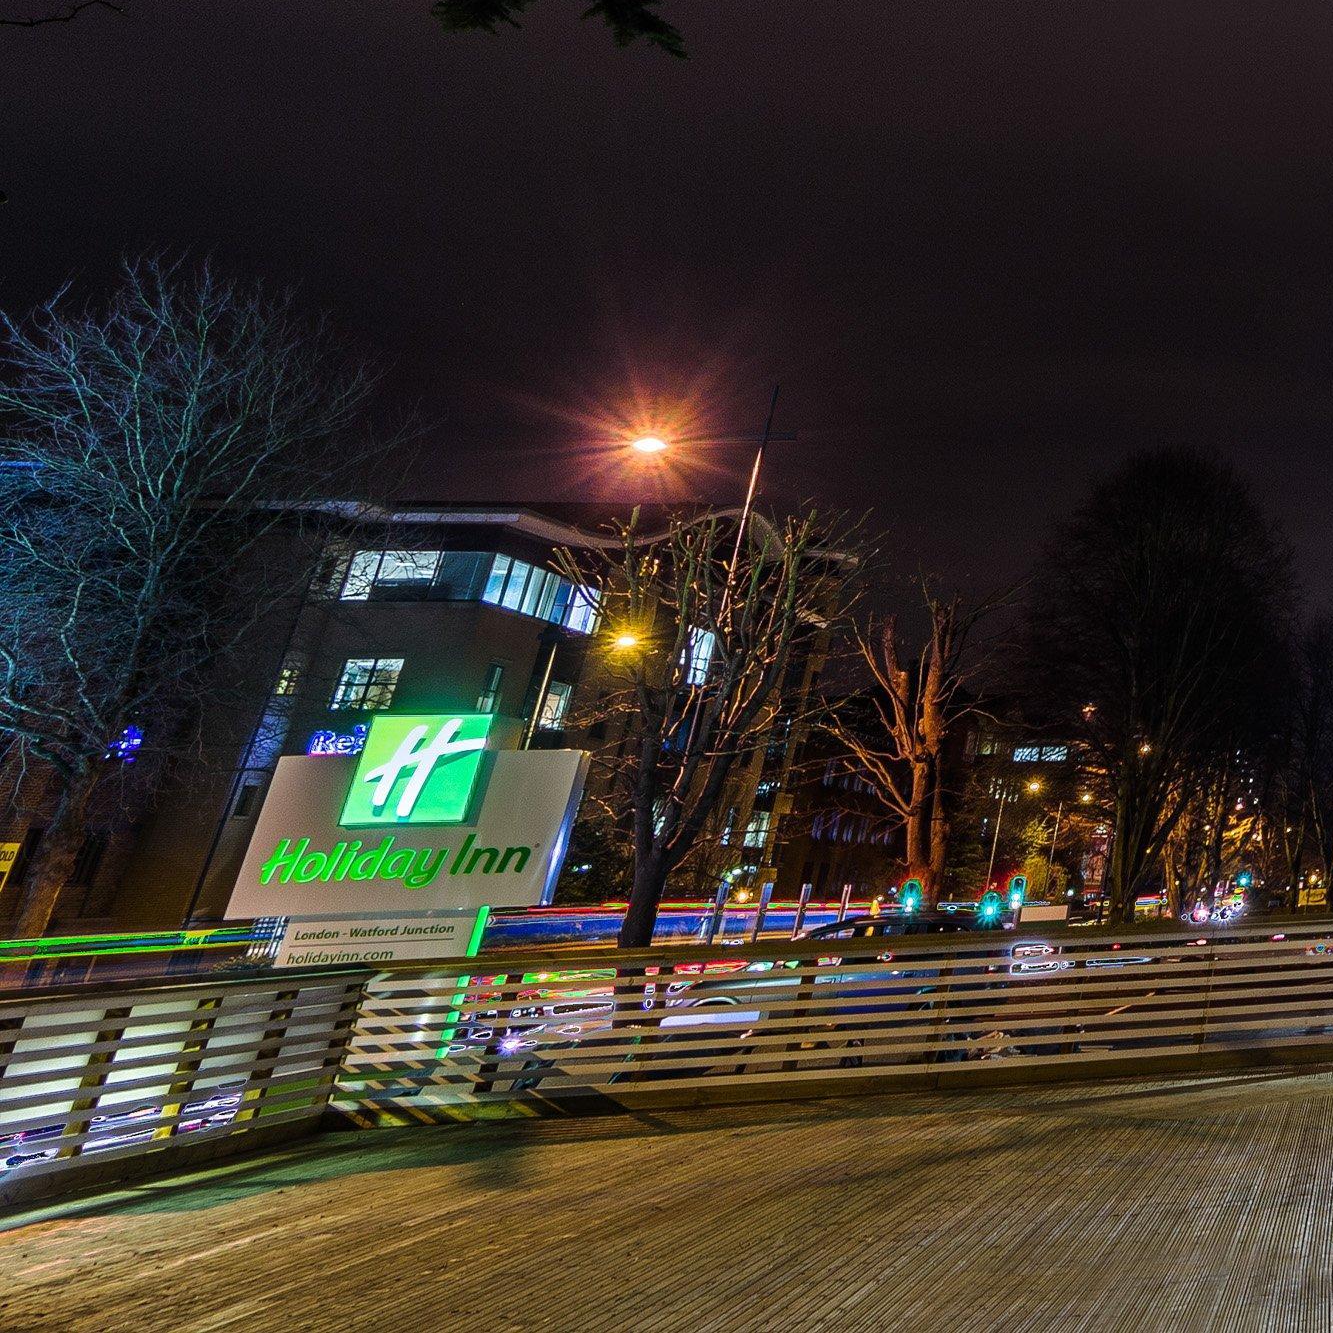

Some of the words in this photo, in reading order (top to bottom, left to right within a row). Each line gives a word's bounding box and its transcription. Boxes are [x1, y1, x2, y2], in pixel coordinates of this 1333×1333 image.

[260, 836, 450, 889] Holiday
[449, 834, 532, 876] Inn
[294, 927, 339, 941] London
[349, 924, 400, 938] Watford
[400, 922, 455, 936] Junction
[286, 949, 394, 966] holidayinn.com
